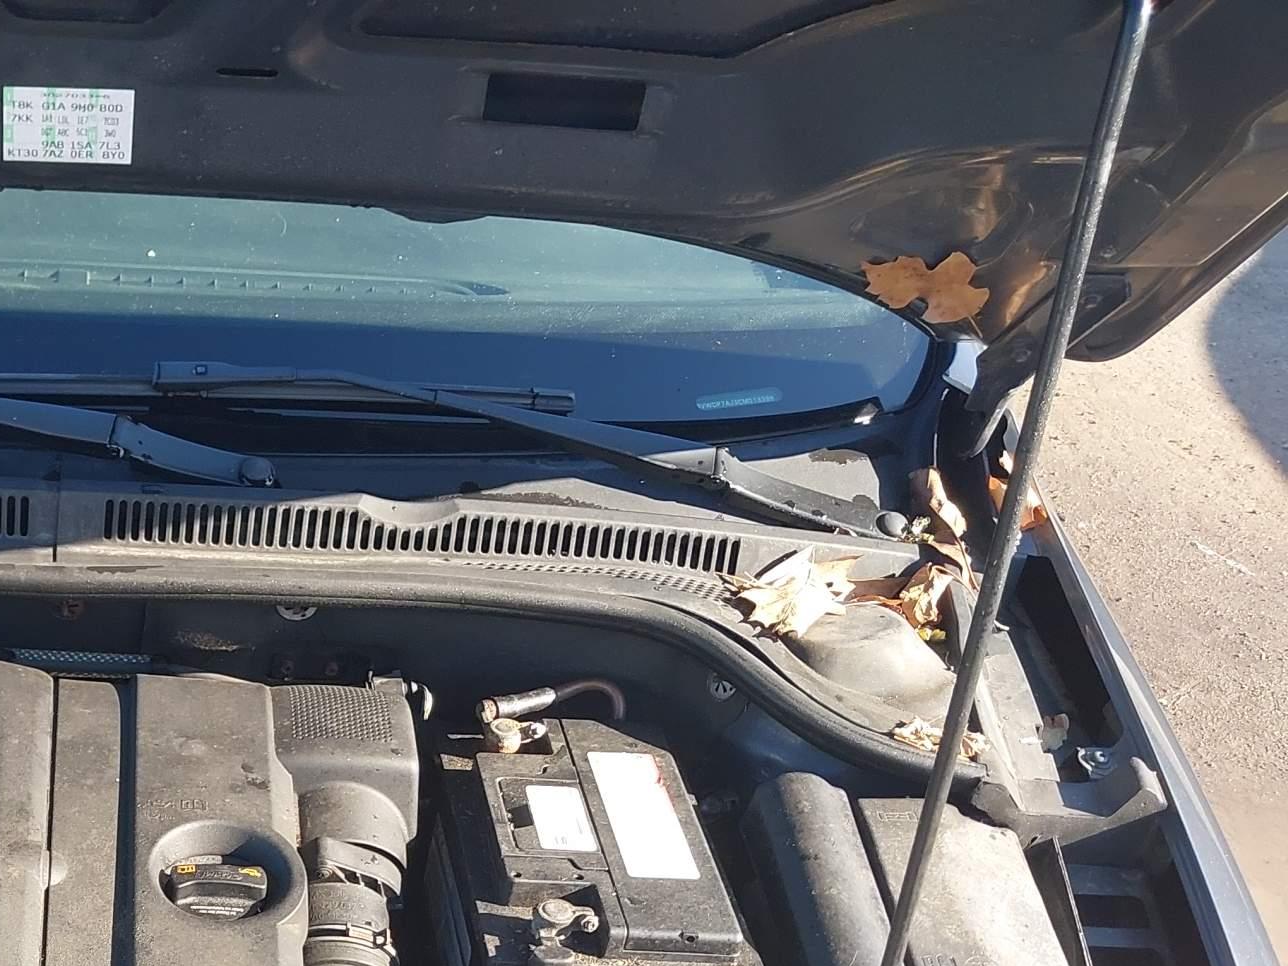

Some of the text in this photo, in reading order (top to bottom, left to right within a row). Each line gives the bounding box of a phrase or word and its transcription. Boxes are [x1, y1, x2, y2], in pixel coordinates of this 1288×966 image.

[11, 114, 33, 122] 7KK
[41, 141, 65, 149] 9AB
[99, 142, 121, 150] 7L3
[7, 148, 39, 158] KT30
[42, 149, 64, 158] 7AZ
